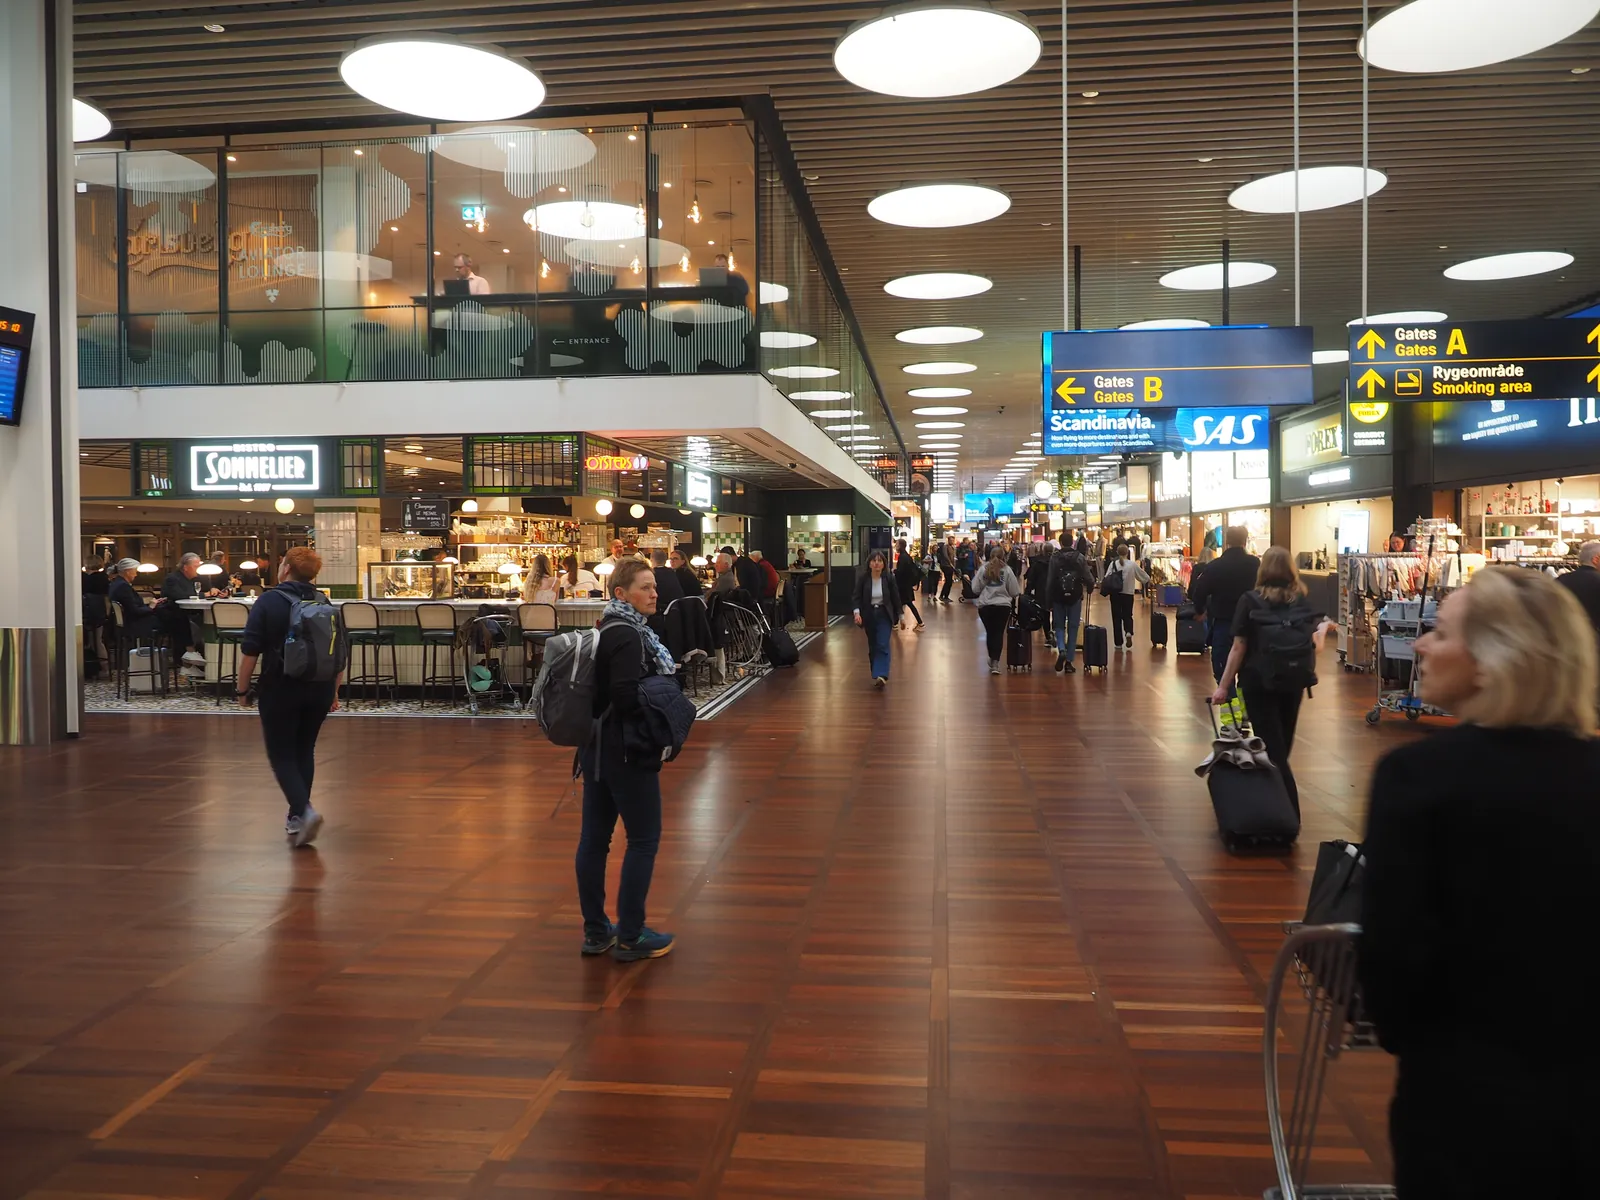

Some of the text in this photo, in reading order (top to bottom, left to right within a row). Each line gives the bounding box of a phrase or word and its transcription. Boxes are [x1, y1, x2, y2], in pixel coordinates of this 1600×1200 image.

[239, 246, 305, 261] AVIATOR
[239, 263, 305, 280] LOUNGE
[569, 337, 610, 345] ENTRANCE
[1395, 327, 1437, 341] Gates
[1395, 328, 1468, 357] Gates A
[1432, 364, 1524, 381] Rygeområde
[1094, 375, 1134, 388] Gates
[1094, 376, 1163, 403] Gates B
[1432, 380, 1533, 396] Smoking area
[1050, 414, 1156, 431] Scandinavia.
[1184, 415, 1262, 446] SAS
[1063, 434, 1077, 442] flying
[204, 451, 306, 484] SOMMELIER
[586, 456, 633, 470] OYSTERS
